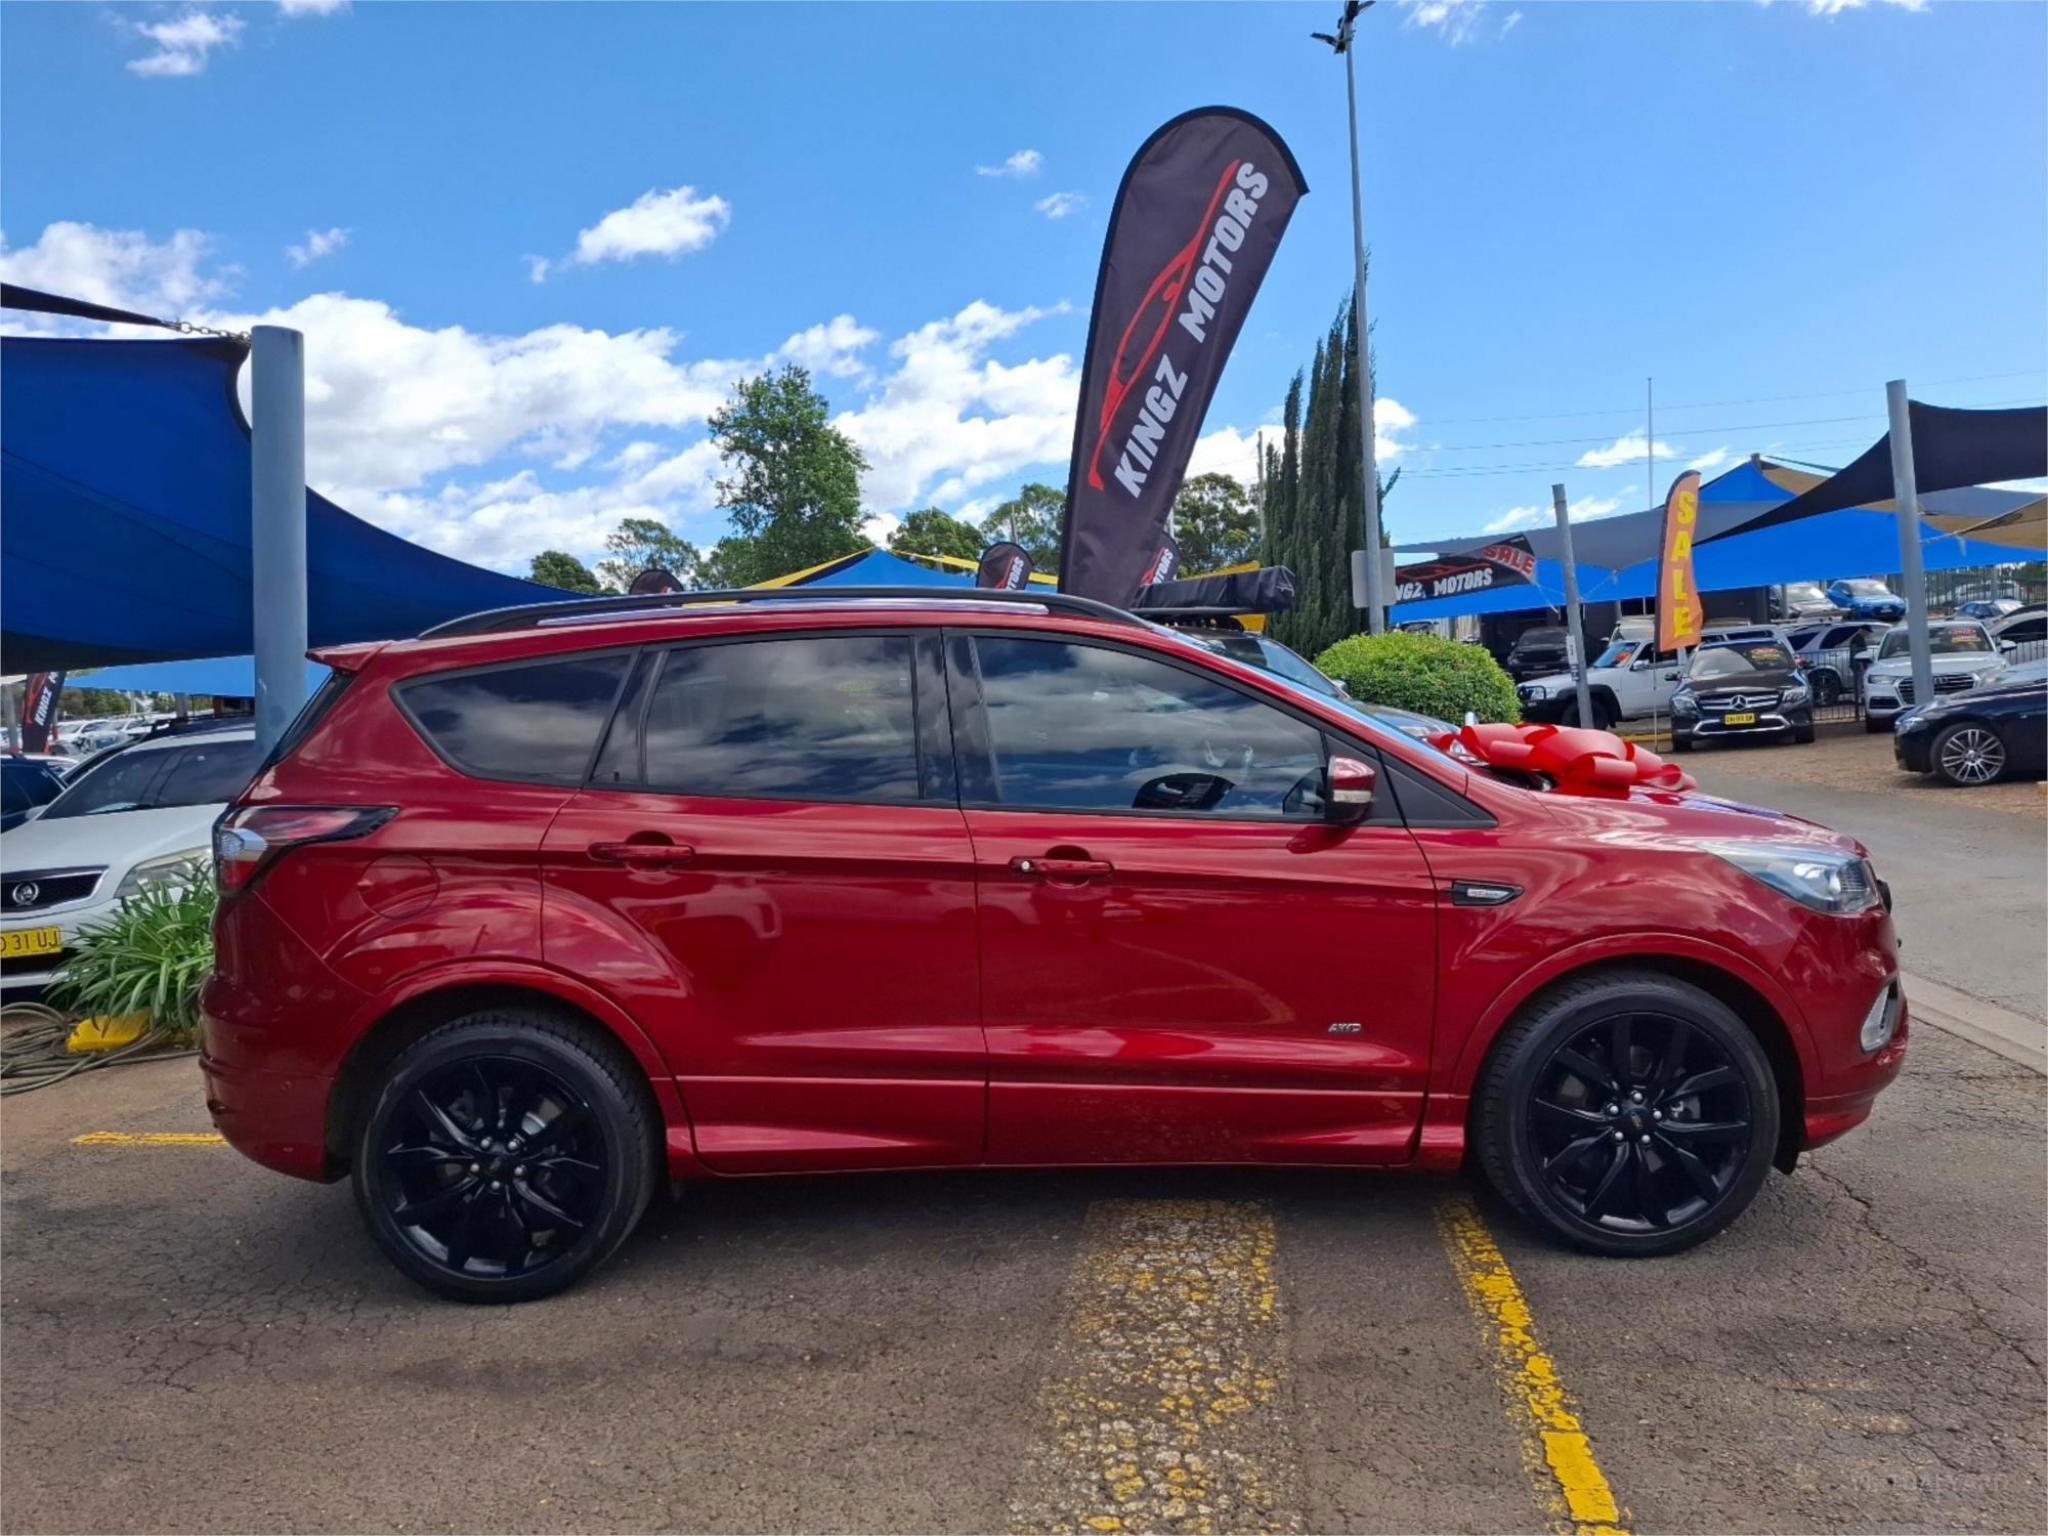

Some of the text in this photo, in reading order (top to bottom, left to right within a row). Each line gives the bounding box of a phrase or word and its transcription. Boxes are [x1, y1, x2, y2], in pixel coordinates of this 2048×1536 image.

[1113, 161, 1270, 499] KINGZ MOTORS
[1432, 567, 1494, 597] MOTORS
[1481, 544, 1536, 577] SALE
[1671, 491, 1697, 638] SALE
